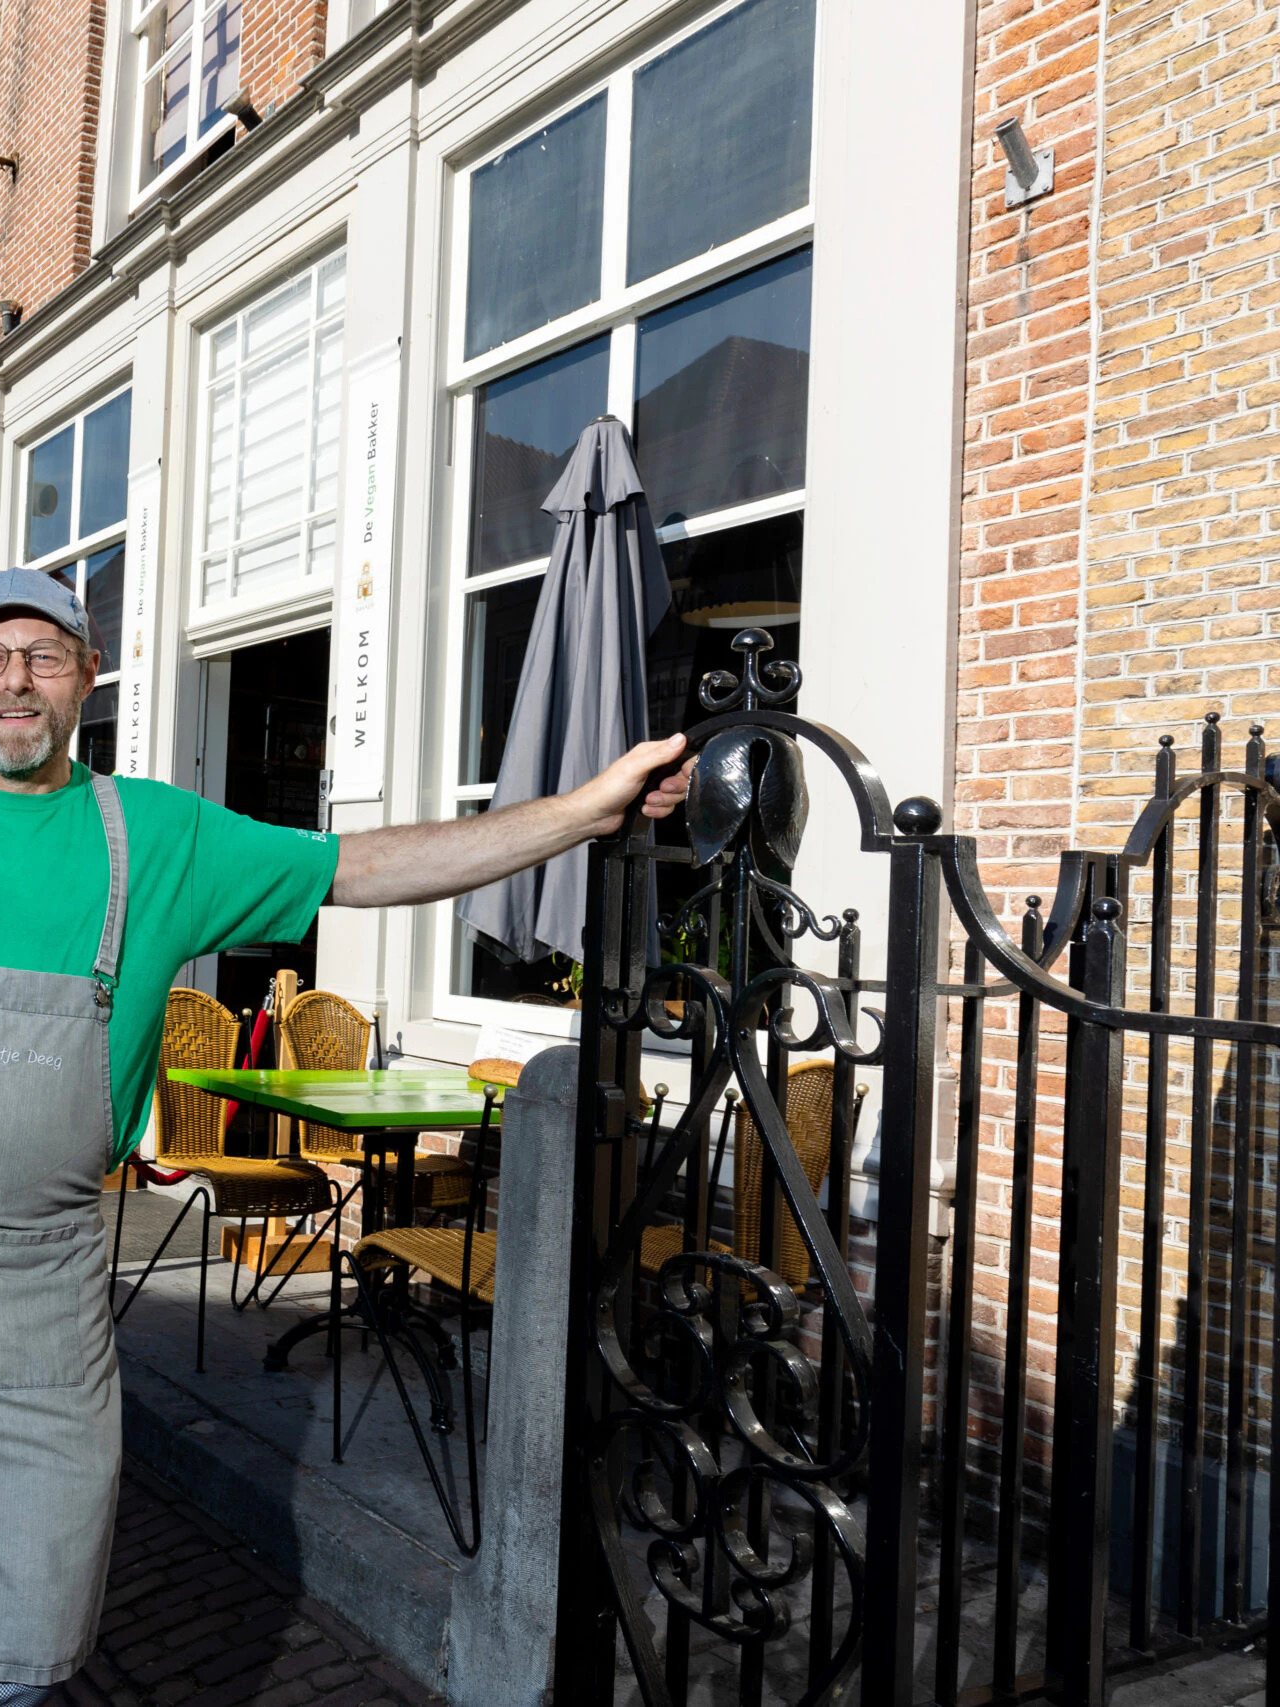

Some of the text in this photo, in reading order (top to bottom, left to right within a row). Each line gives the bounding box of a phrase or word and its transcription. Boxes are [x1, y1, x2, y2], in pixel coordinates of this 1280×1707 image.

[363, 402, 379, 543] De Vegan Bakker
[136, 507, 149, 616] De Vegan Bakker
[129, 683, 141, 774] WELKOM
[354, 630, 370, 748] WELKOM
[27, 1049, 63, 1071] Deeg
